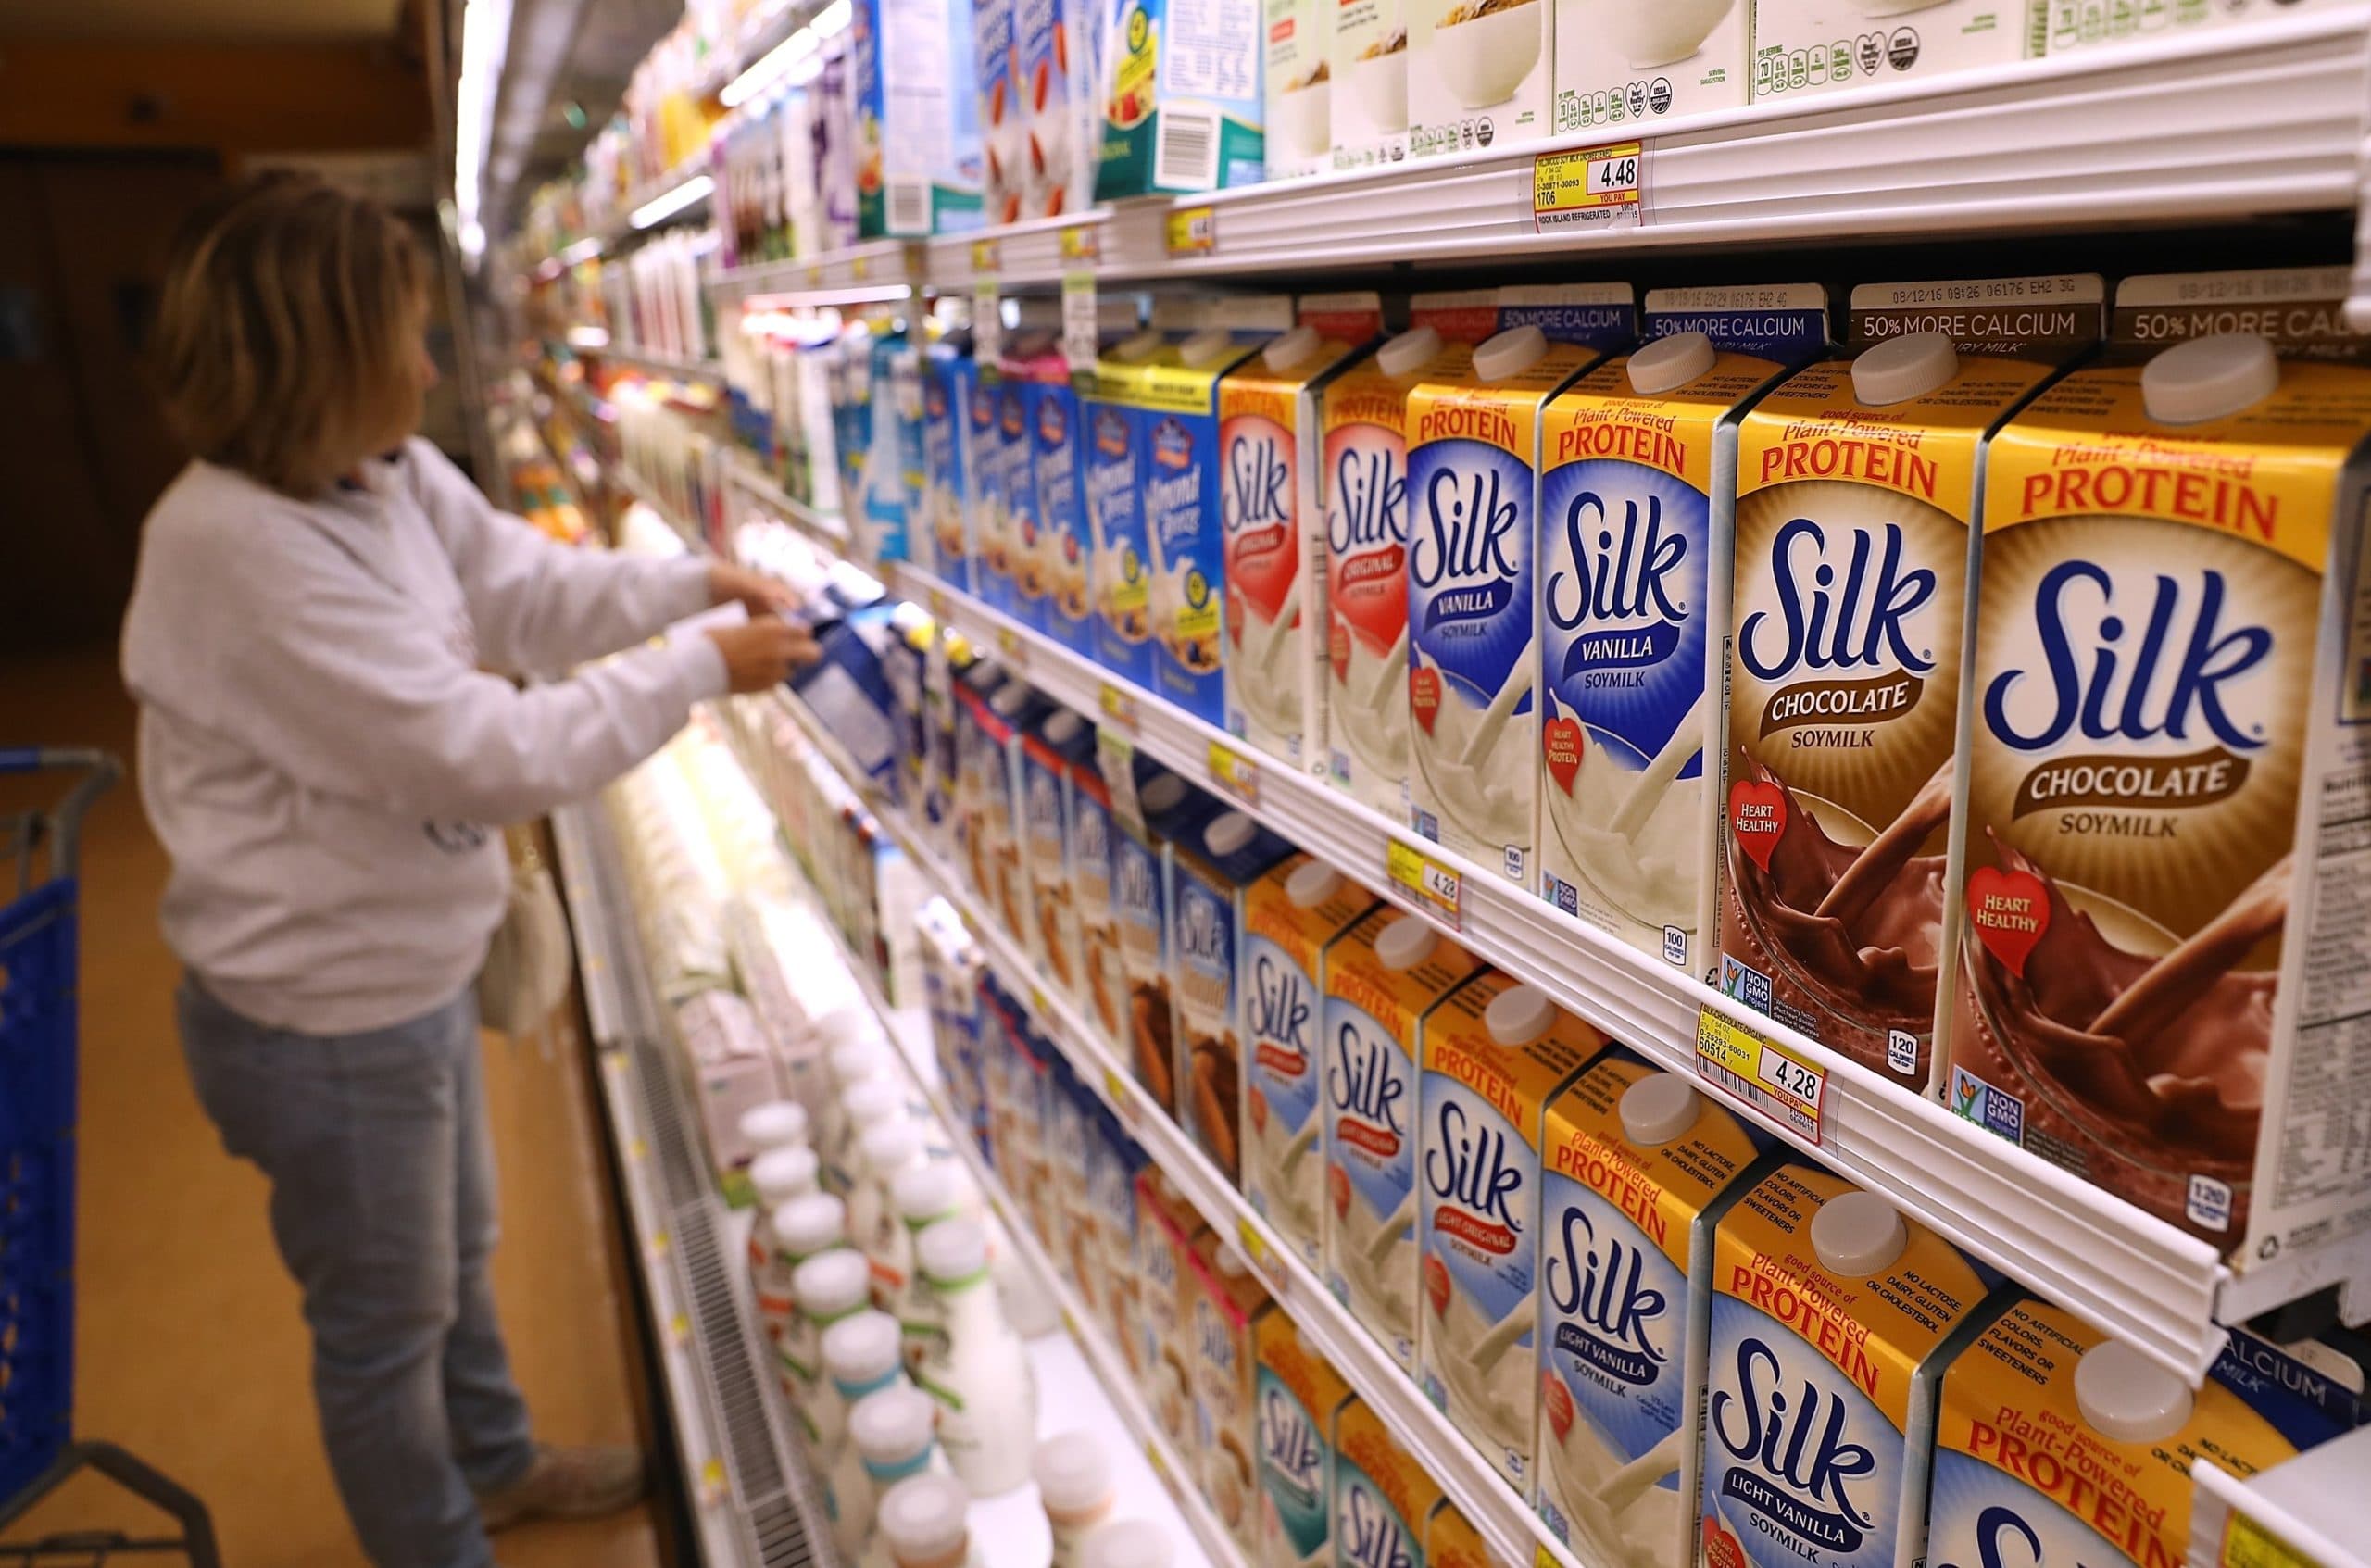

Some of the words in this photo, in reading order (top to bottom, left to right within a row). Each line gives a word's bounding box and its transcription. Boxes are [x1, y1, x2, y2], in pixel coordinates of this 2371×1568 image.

[1700, 76, 1725, 85] SUGGESTION
[1600, 158, 1635, 187] 4.48
[1537, 191, 1555, 206] 1706
[1600, 194, 1612, 203] YOU
[1613, 193, 1625, 201] PAY
[1538, 215, 1551, 224] ROCK
[1572, 210, 1611, 221] REFRIGERATED
[1892, 288, 1942, 304] 08/12/16
[1948, 285, 1980, 301] 08:26
[1986, 282, 2024, 297] 06176
[2030, 280, 2052, 295] EH2
[1529, 311, 1562, 326] MORE
[1564, 310, 1621, 327] CALCIUM
[1655, 318, 1682, 336] 50%
[1684, 318, 1728, 337] MORE
[1732, 317, 1805, 336] CALCIUM
[1863, 317, 1900, 337] 50%
[1904, 315, 1966, 336] MORE
[1971, 312, 2076, 336] CALCIUM
[2134, 314, 2186, 339] 50%
[2190, 311, 2279, 337] MORE
[1420, 408, 1516, 451] PROTEIN
[1574, 408, 1676, 433] Plant-Powered
[1820, 408, 1850, 420] good
[1558, 423, 1687, 475] PROTEIN
[1783, 420, 1925, 450] Plant-Powered
[1760, 439, 1941, 498] PROTEIN
[2052, 441, 2258, 480] Plant-Powered
[1224, 436, 1288, 533] Silk
[1329, 447, 1408, 555] Silk
[2020, 466, 2279, 542] PROTEIN
[1411, 467, 1520, 589] Silk
[1345, 553, 1394, 578] ORIGINAL
[1546, 492, 1689, 630] Silk
[1438, 590, 1493, 615] VANILLA
[1739, 519, 1937, 680] Silk
[1441, 621, 1487, 640] SOYMILK
[1582, 636, 1653, 661] VANILLA
[1984, 559, 2274, 751] Silk
[1585, 671, 1645, 689] SOYMILK
[1772, 682, 1909, 721] CHOCOLATE
[1791, 730, 1875, 748] SOYMILK
[1549, 750, 1578, 764] PROTEIN
[2030, 760, 2232, 800] CHOCOLATE
[1736, 818, 1778, 833] HEALTHY
[1741, 804, 1774, 817] HEART
[2059, 813, 2178, 838] SOYMILK
[1985, 894, 2031, 912] HEART
[1976, 909, 2039, 933] HEALTHY
[1667, 931, 1683, 947] 100
[1745, 985, 1768, 1002] GMO
[1746, 972, 1768, 991] NON
[1250, 954, 1310, 1055] Silk
[1745, 995, 1768, 1011] Project
[1699, 1037, 1726, 1063] 60514
[1700, 1029, 1750, 1060] 0-25293-60031
[1891, 1035, 1913, 1055] 120
[1329, 1022, 1405, 1137] Silk
[1435, 1046, 1522, 1127] PROTEIN
[1775, 1060, 1816, 1100] 4.28
[1774, 1086, 1789, 1102] YOU
[1789, 1096, 1804, 1110] PAY
[1988, 1091, 2019, 1115] NON
[1987, 1105, 2019, 1128] GMO
[1692, 1139, 1704, 1151] NO
[1426, 1100, 1524, 1233] Silk
[1571, 1130, 1662, 1204] Plant-Powered
[1670, 1156, 1716, 1190] CHOLESTEROL
[1699, 1156, 1727, 1181] GLUTEN
[1775, 1172, 1790, 1185] NO
[1555, 1144, 1668, 1247] PROTEIN
[1754, 1188, 1788, 1213] FLAVORS
[1788, 1206, 1802, 1222] OR
[1763, 1179, 1797, 1204] COLORS,
[1743, 1197, 1796, 1235] SWEETENERS
[1547, 1207, 1667, 1362] Silk
[1784, 1253, 1811, 1274] good
[1809, 1269, 1843, 1297] source
[1843, 1293, 1858, 1305] of
[1904, 1270, 1920, 1284] NO
[1918, 1279, 1963, 1312] LACTOSE,
[1751, 1252, 1871, 1348] Plant-Powered
[1866, 1280, 1881, 1293] OR
[1879, 1288, 1940, 1334] CHOLESTEROL
[1886, 1276, 1915, 1299] DAIRY,
[1914, 1295, 1952, 1323] GLUTEN
[1730, 1265, 1880, 1397] PROTEIN
[2001, 1318, 2043, 1348] COLORS,
[2011, 1308, 2029, 1323] NO
[2027, 1318, 2084, 1356] ARTIFICIAL
[1559, 1326, 1592, 1353] LIGHT
[1592, 1342, 1646, 1378] VANILLA
[1977, 1339, 2049, 1386] SWEETENERS
[1989, 1328, 2038, 1361] FLAVORS
[2036, 1356, 2055, 1372] OR
[1574, 1359, 1626, 1399] SOYMILK
[2223, 1338, 2327, 1407] ALCIUM
[1260, 1388, 1321, 1493] Silk
[1712, 1338, 1875, 1529] Silk
[2039, 1409, 2076, 1435] good
[2075, 1435, 2123, 1465] source
[2124, 1463, 2142, 1477] of
[1995, 1406, 2166, 1534] Plant-Powered
[1731, 1474, 1774, 1507] LIGHT
[1775, 1497, 1846, 1544] VANILLA
[1967, 1418, 2186, 1568] PROTEIN
[1749, 1512, 1821, 1565] SOYMILK
